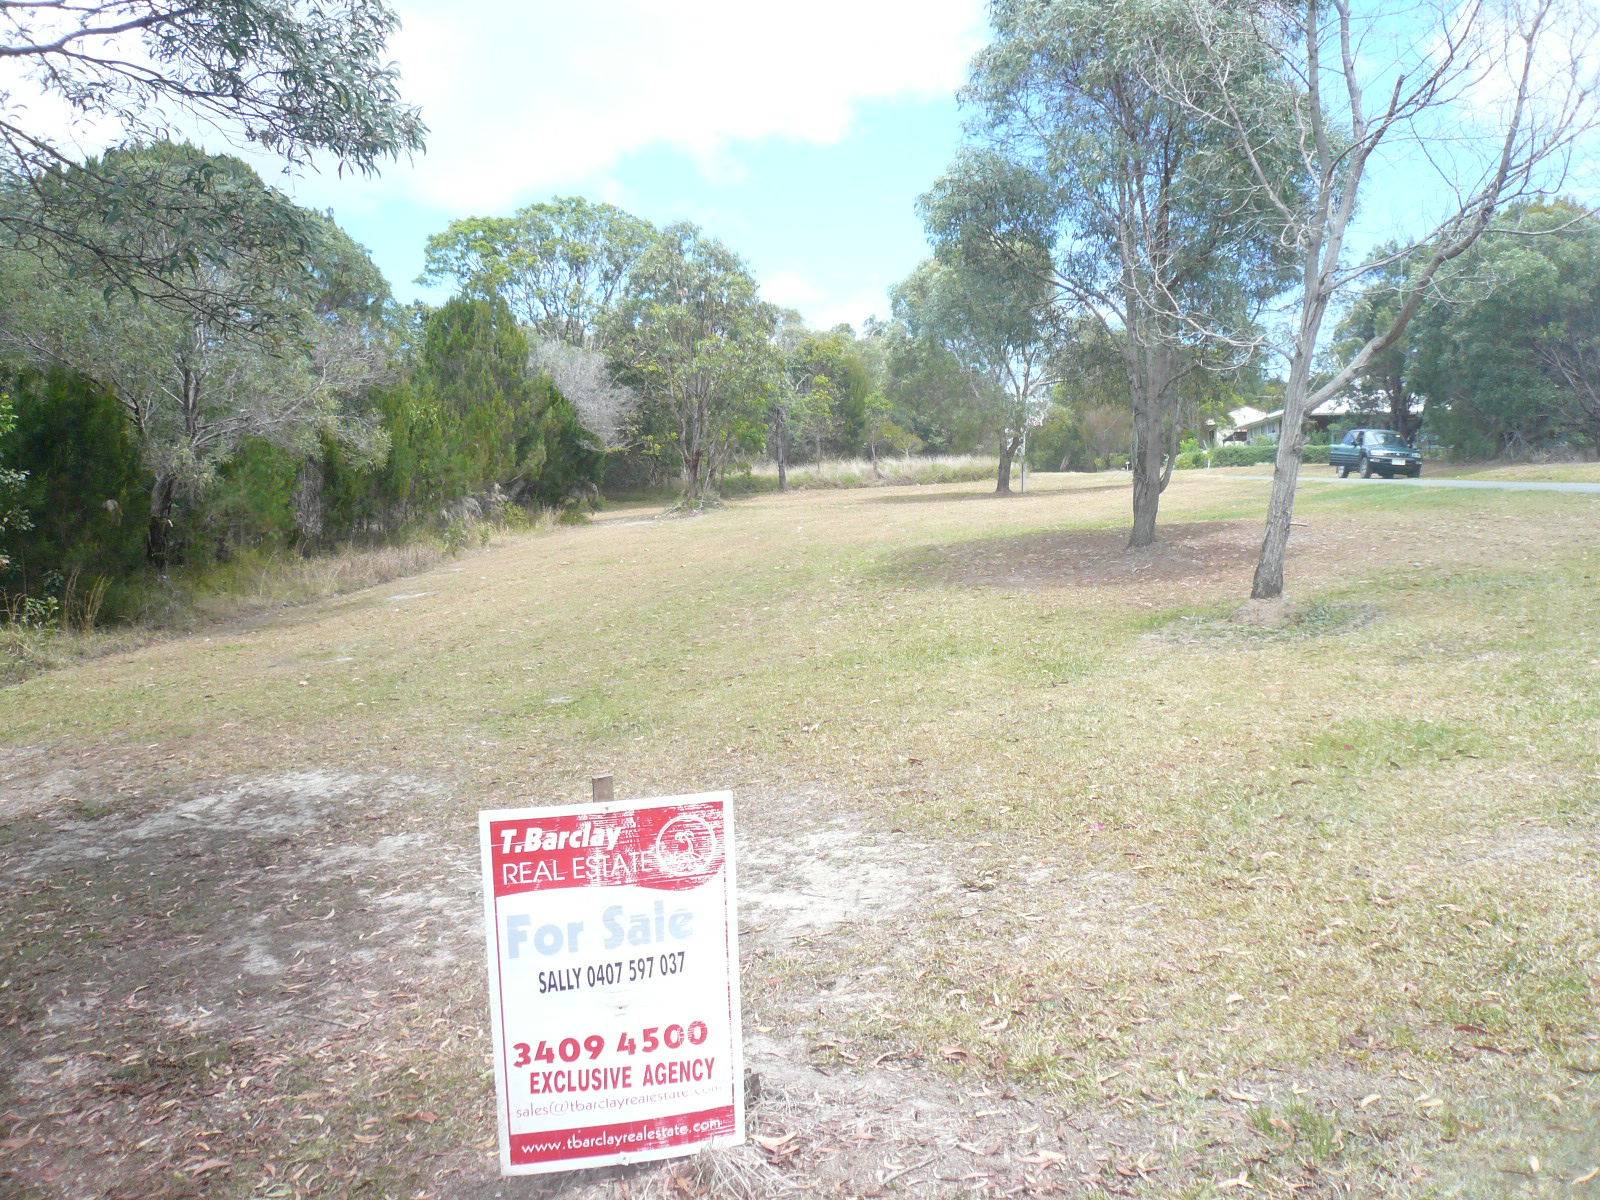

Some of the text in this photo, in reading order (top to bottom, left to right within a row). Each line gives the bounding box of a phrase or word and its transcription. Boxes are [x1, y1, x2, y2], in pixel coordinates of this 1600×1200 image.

[500, 821, 621, 854] T.Barclay
[503, 850, 655, 885] REAL ESTATE
[507, 901, 694, 959] For Sale
[538, 951, 685, 994] SALLY 0407 597 037
[513, 1020, 708, 1068] 3409 4500
[529, 1057, 715, 1094] EXCLUSIVE AGENCY
[516, 1085, 722, 1118] sales@tbarclayrealestatec
